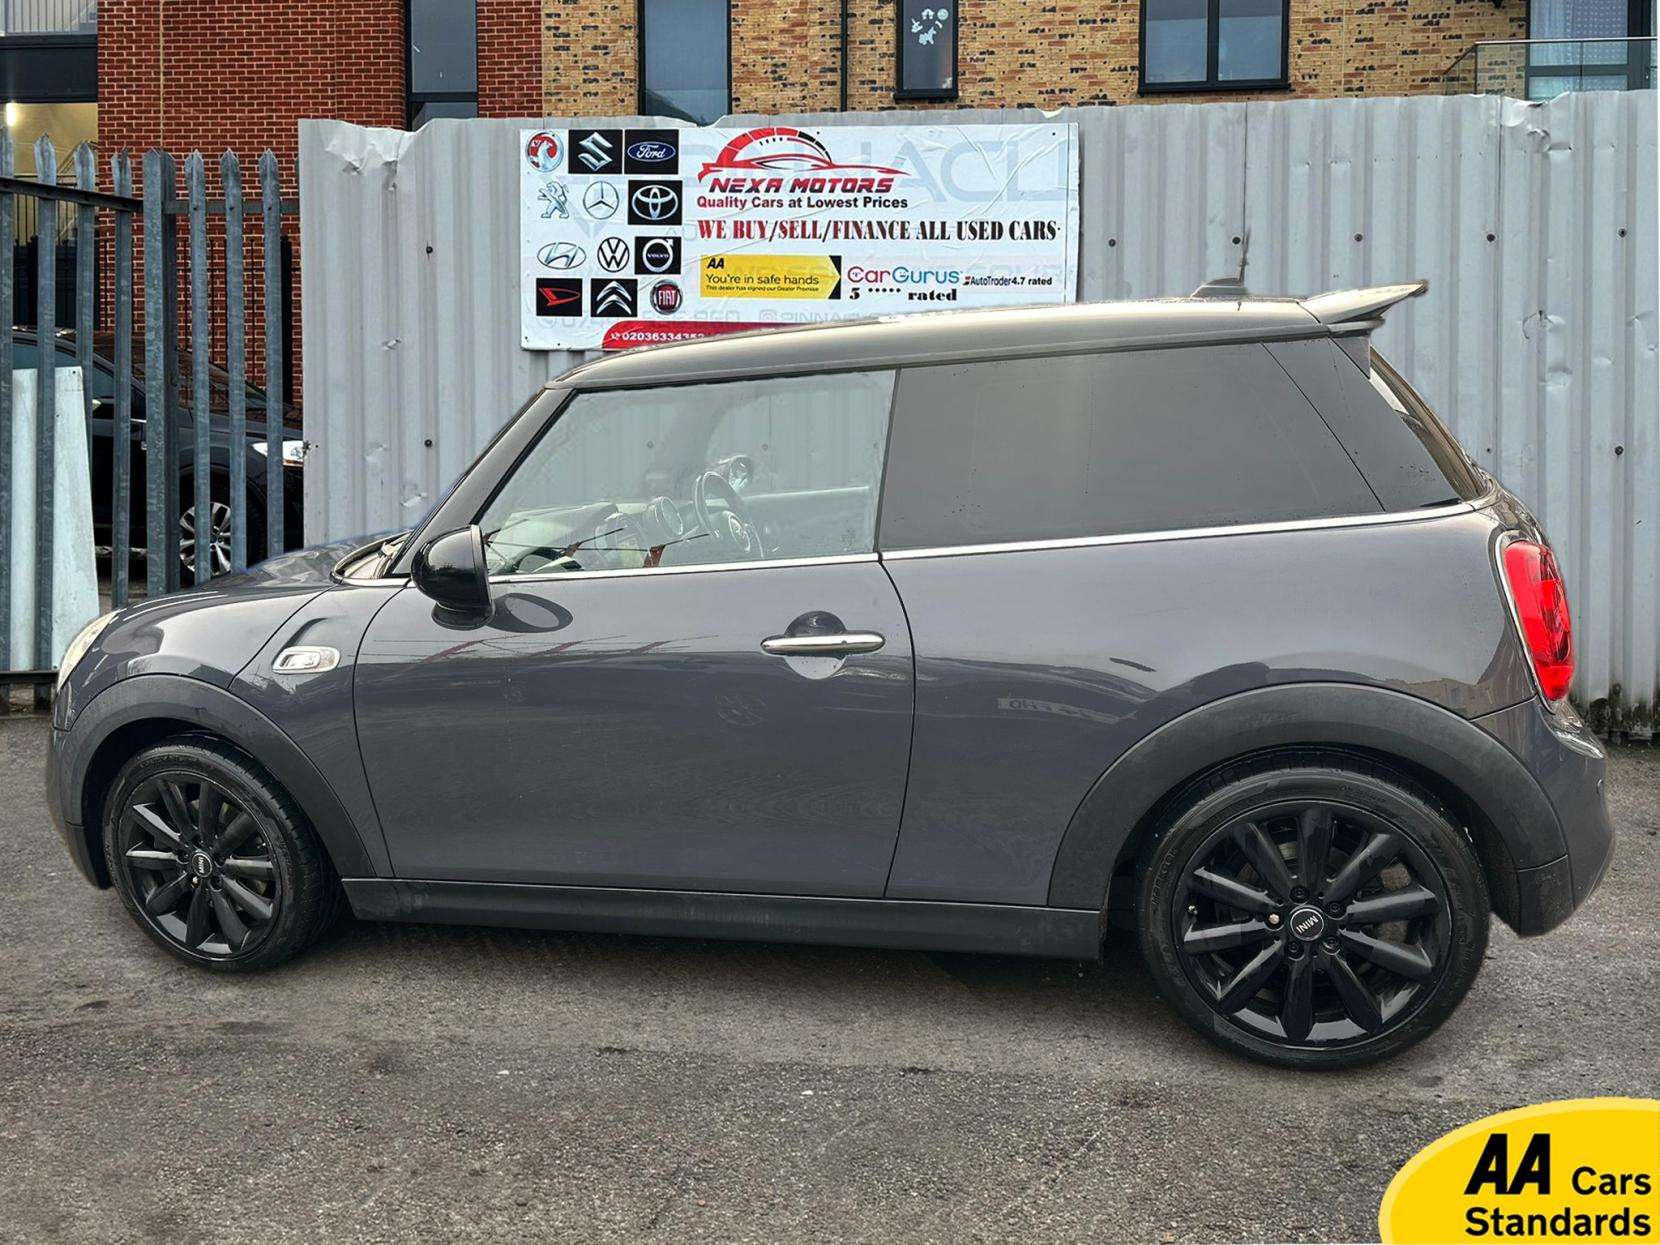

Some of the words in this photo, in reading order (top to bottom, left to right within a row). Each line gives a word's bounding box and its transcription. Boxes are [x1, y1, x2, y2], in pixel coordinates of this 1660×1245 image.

[709, 178, 783, 193] NEXA
[789, 178, 894, 193] MOTORS
[697, 197, 746, 210] Quality
[751, 196, 784, 208] Cars
[788, 198, 802, 208] at
[807, 197, 858, 208] Lowest
[863, 196, 908, 208] Prices
[698, 220, 727, 240] WE
[916, 221, 951, 240] ALL
[956, 221, 1004, 240] USED
[1009, 220, 1057, 240] CARS
[707, 258, 724, 269] AA
[706, 274, 741, 284] You're
[744, 274, 754, 283] in
[757, 274, 781, 285] safe
[784, 275, 819, 285] hands
[847, 266, 960, 284] CarGurus
[1028, 277, 1052, 286] rated
[658, 290, 676, 306] FIAT
[908, 289, 957, 301] rated
[1296, 915, 1319, 934] MINI
